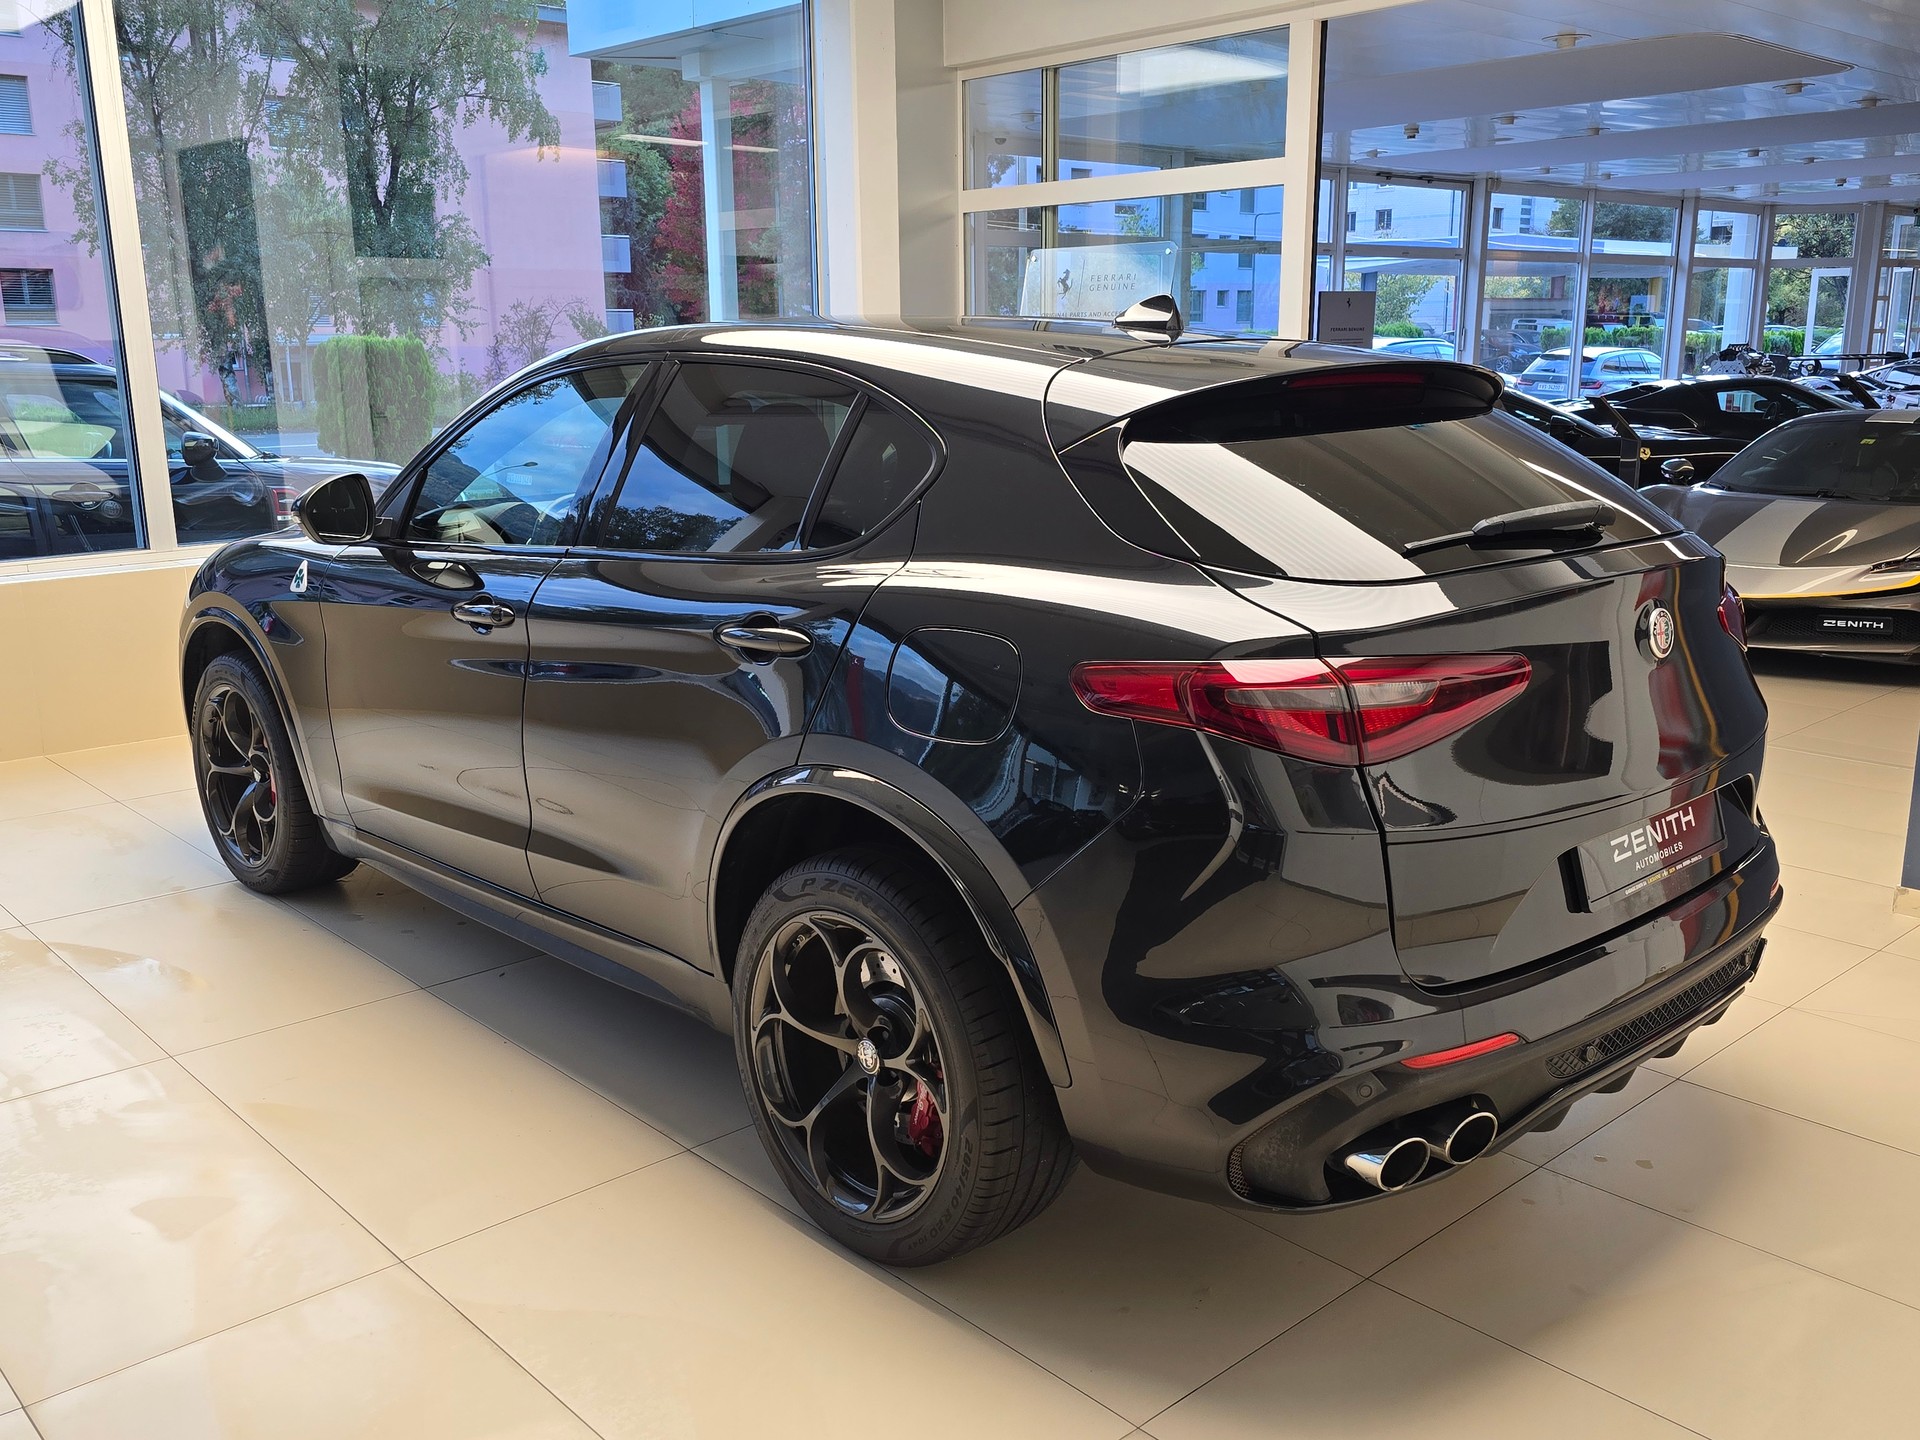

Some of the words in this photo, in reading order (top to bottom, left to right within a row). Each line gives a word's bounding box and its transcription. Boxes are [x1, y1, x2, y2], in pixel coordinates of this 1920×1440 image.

[1090, 273, 1137, 282] FERRARI
[1089, 282, 1136, 292] GENUINE
[1823, 619, 1884, 629] ZENITH
[1610, 806, 1696, 863] ZENITH
[1635, 841, 1684, 871] AUTOMOBILES
[800, 877, 817, 892] P
